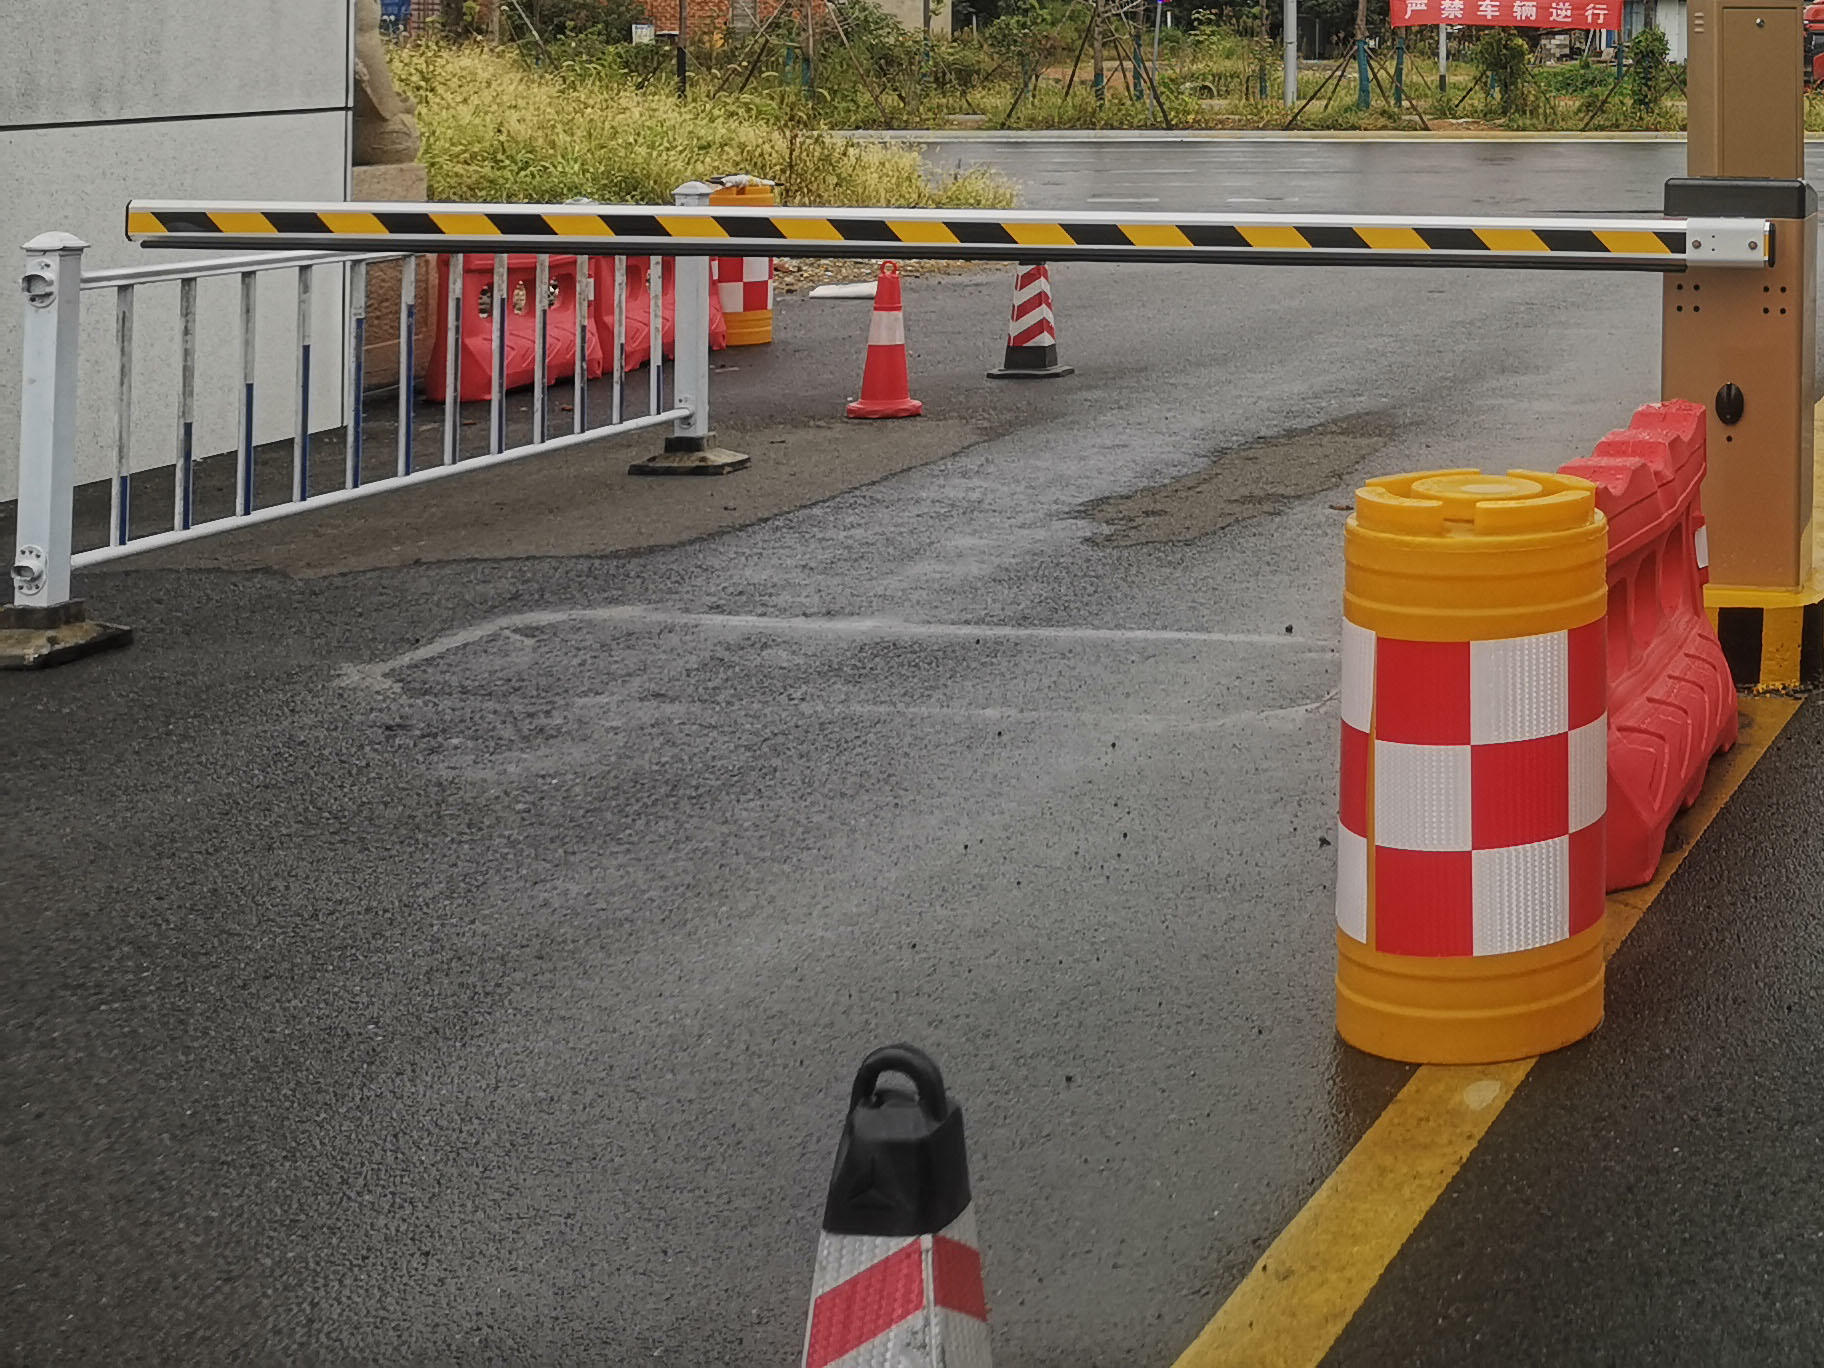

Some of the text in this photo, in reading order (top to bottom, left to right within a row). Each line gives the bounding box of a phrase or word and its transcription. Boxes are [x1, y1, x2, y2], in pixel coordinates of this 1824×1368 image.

[1404, 0, 1609, 24] 严禁车辆逆行
